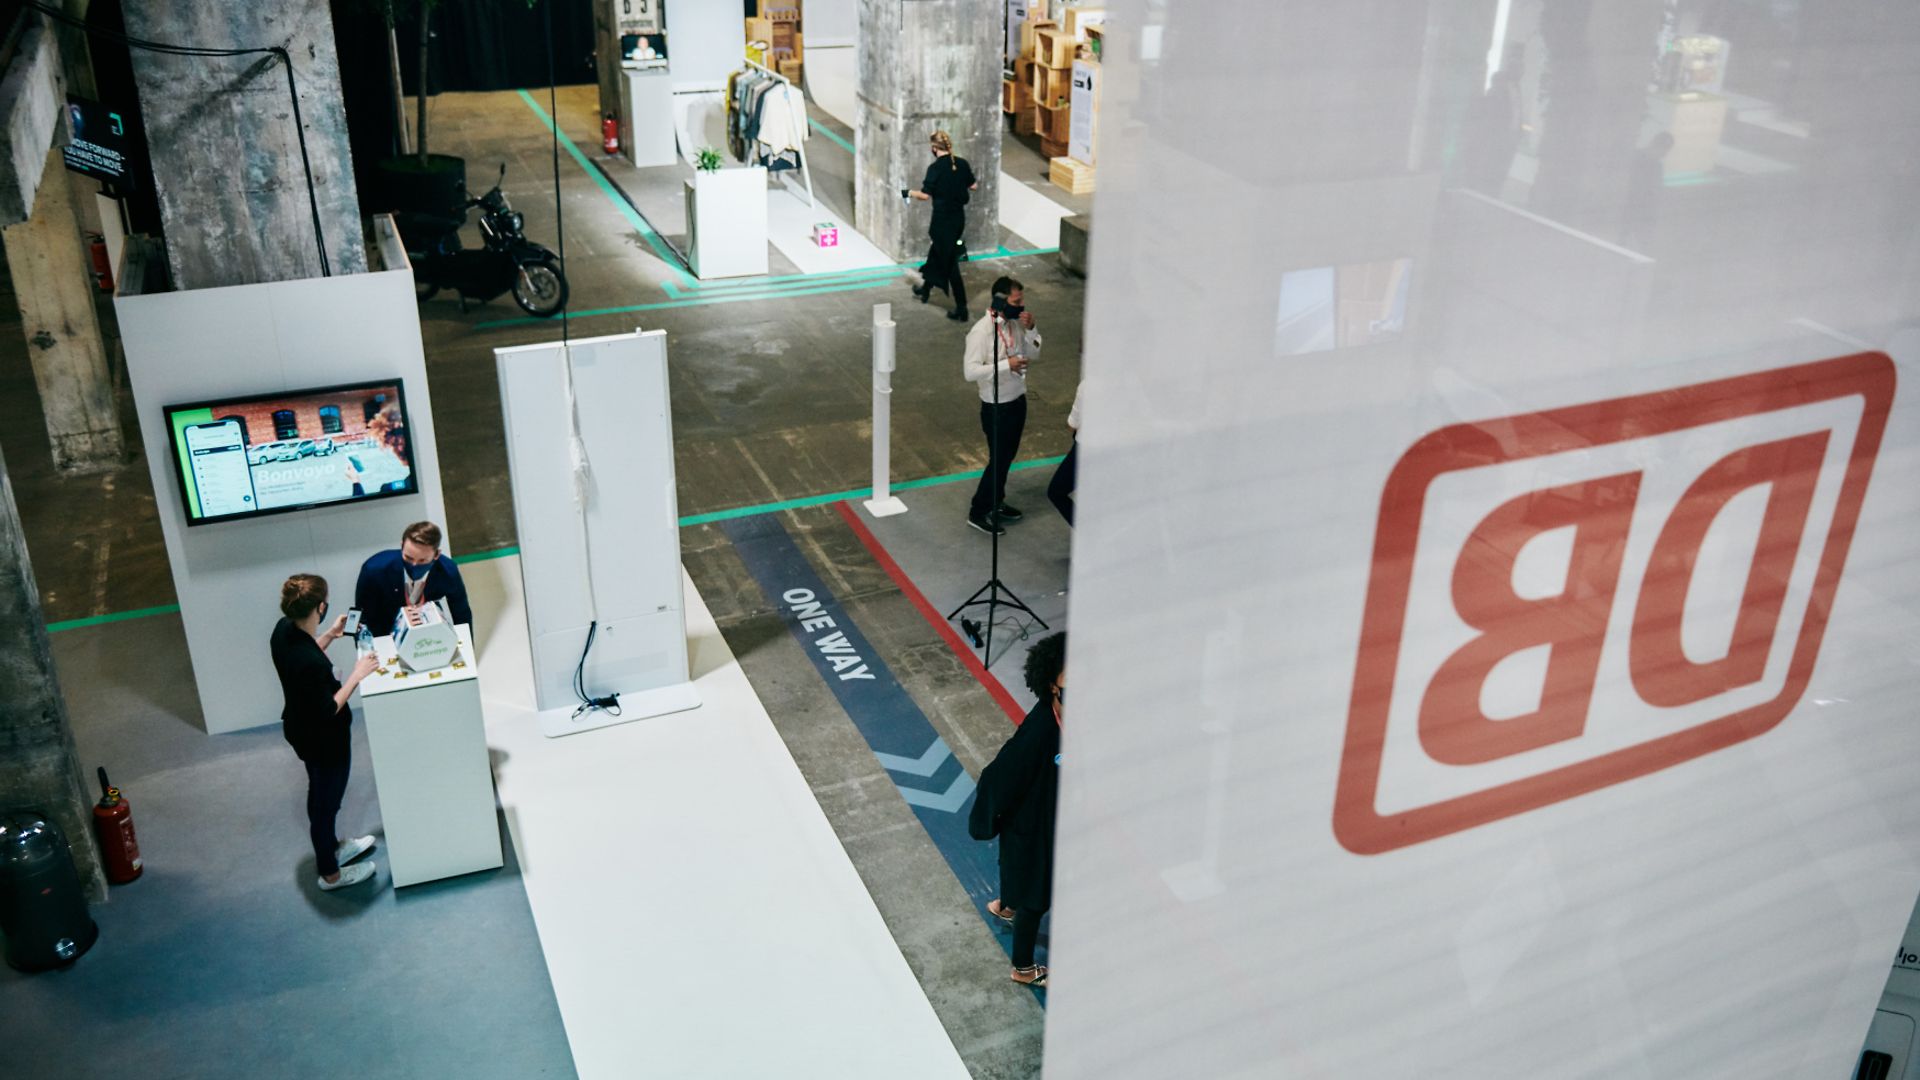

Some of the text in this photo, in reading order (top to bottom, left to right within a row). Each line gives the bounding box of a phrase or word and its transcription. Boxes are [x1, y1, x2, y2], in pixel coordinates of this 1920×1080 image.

[76, 149, 93, 162] HAVE
[93, 153, 103, 165] TO
[783, 588, 876, 680] ONE WAY
